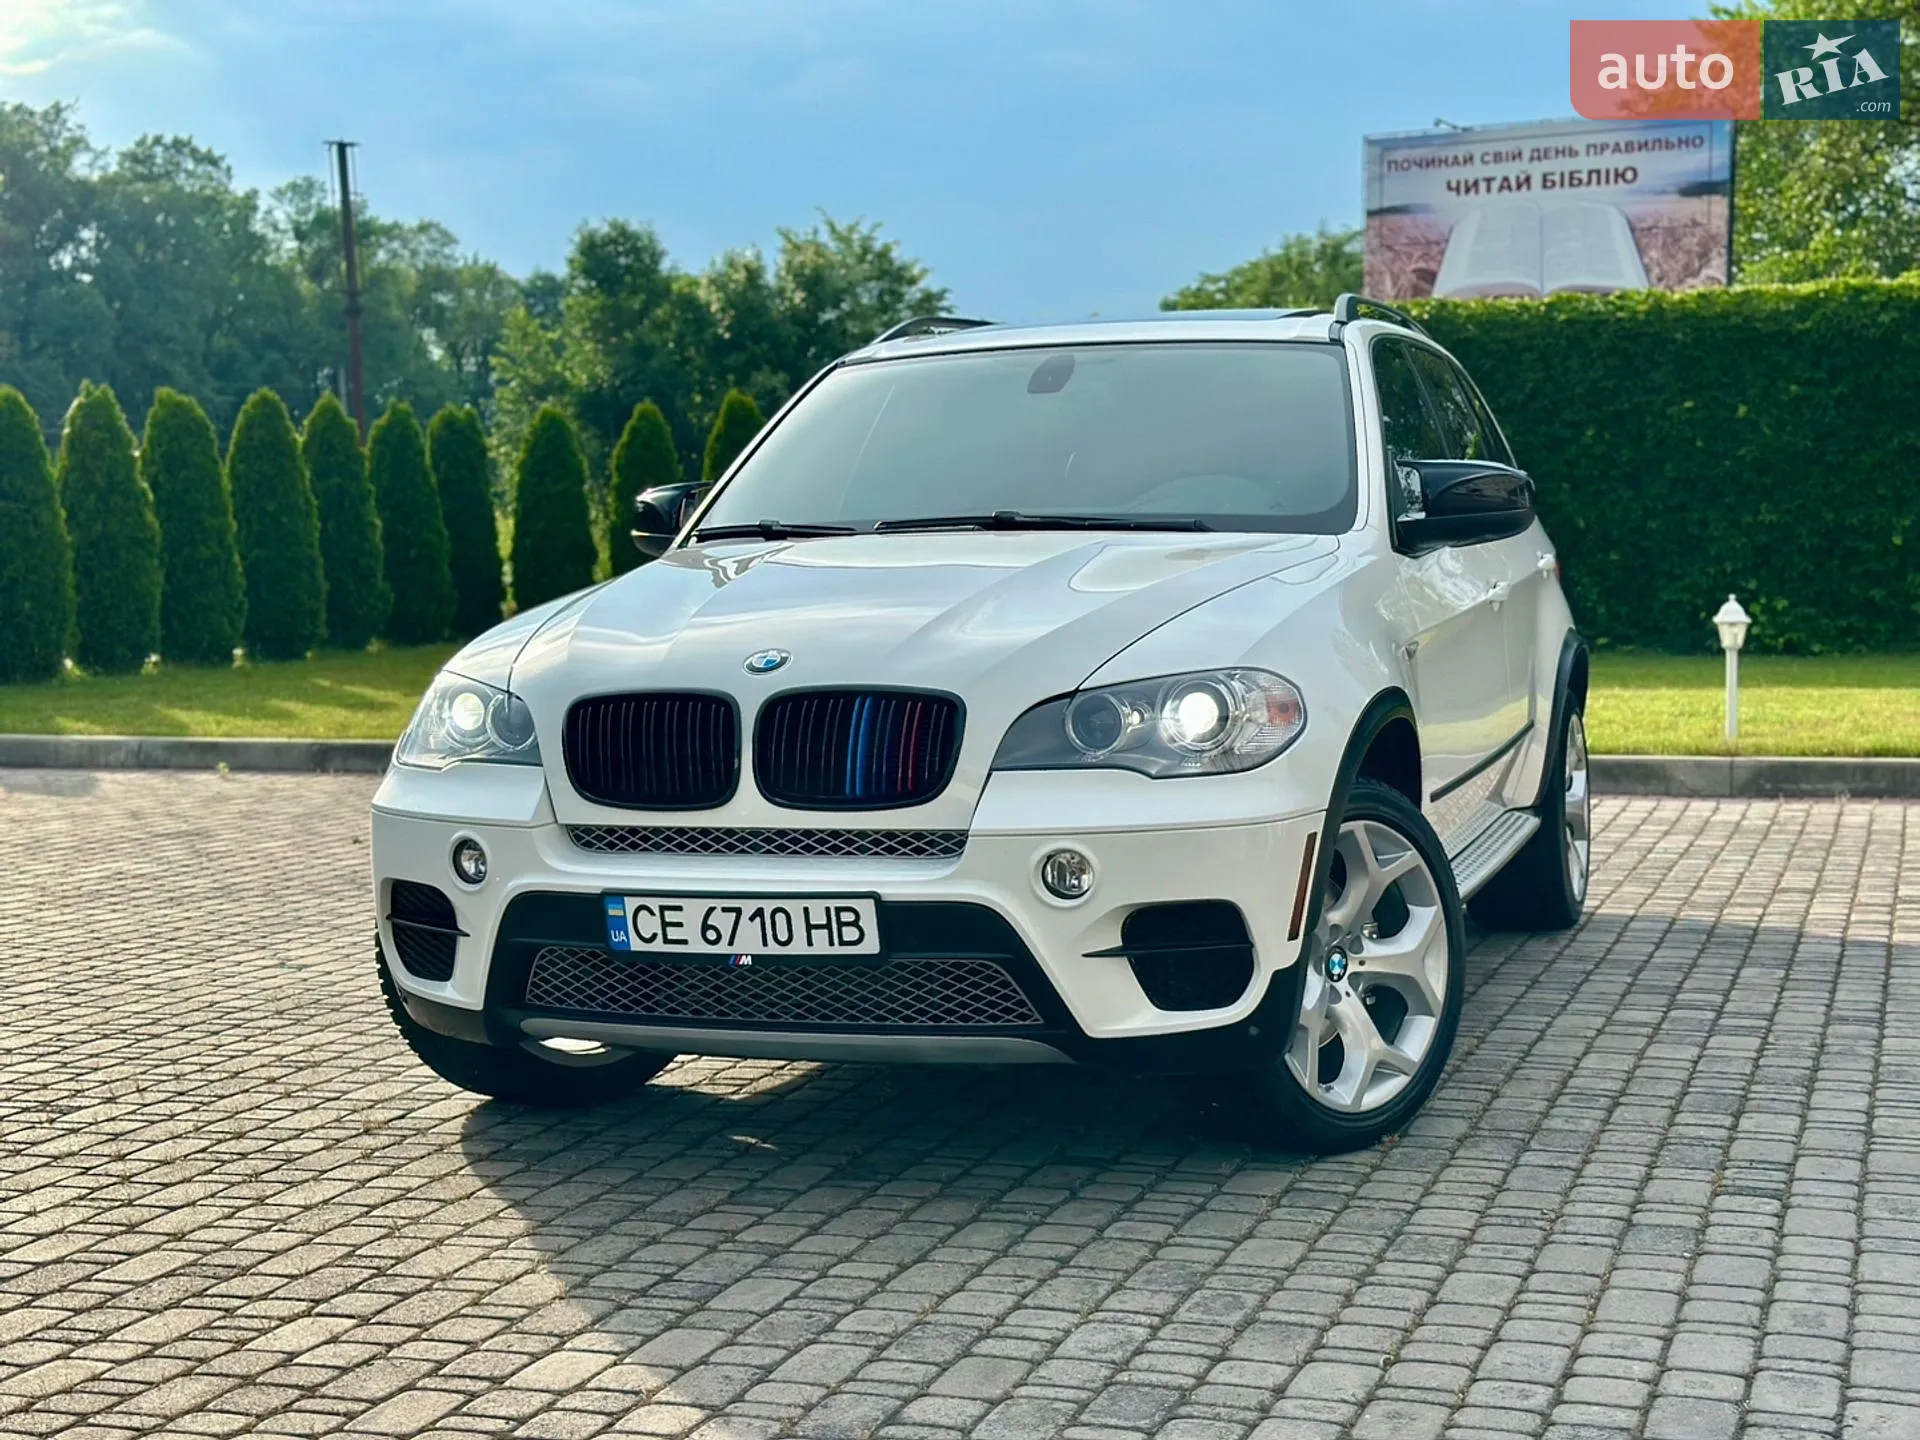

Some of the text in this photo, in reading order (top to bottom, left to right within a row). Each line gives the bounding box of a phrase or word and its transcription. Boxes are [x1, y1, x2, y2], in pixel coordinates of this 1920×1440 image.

[1386, 135, 1705, 172] ПОЧИНАЙ СВІЙ ДЕНЬ ПРАВИЛЬНО
[1446, 166, 1638, 196] ЧИТАЙ БІБЛІЮ
[610, 929, 628, 944] UA
[631, 904, 866, 947] CE 6710 HB
